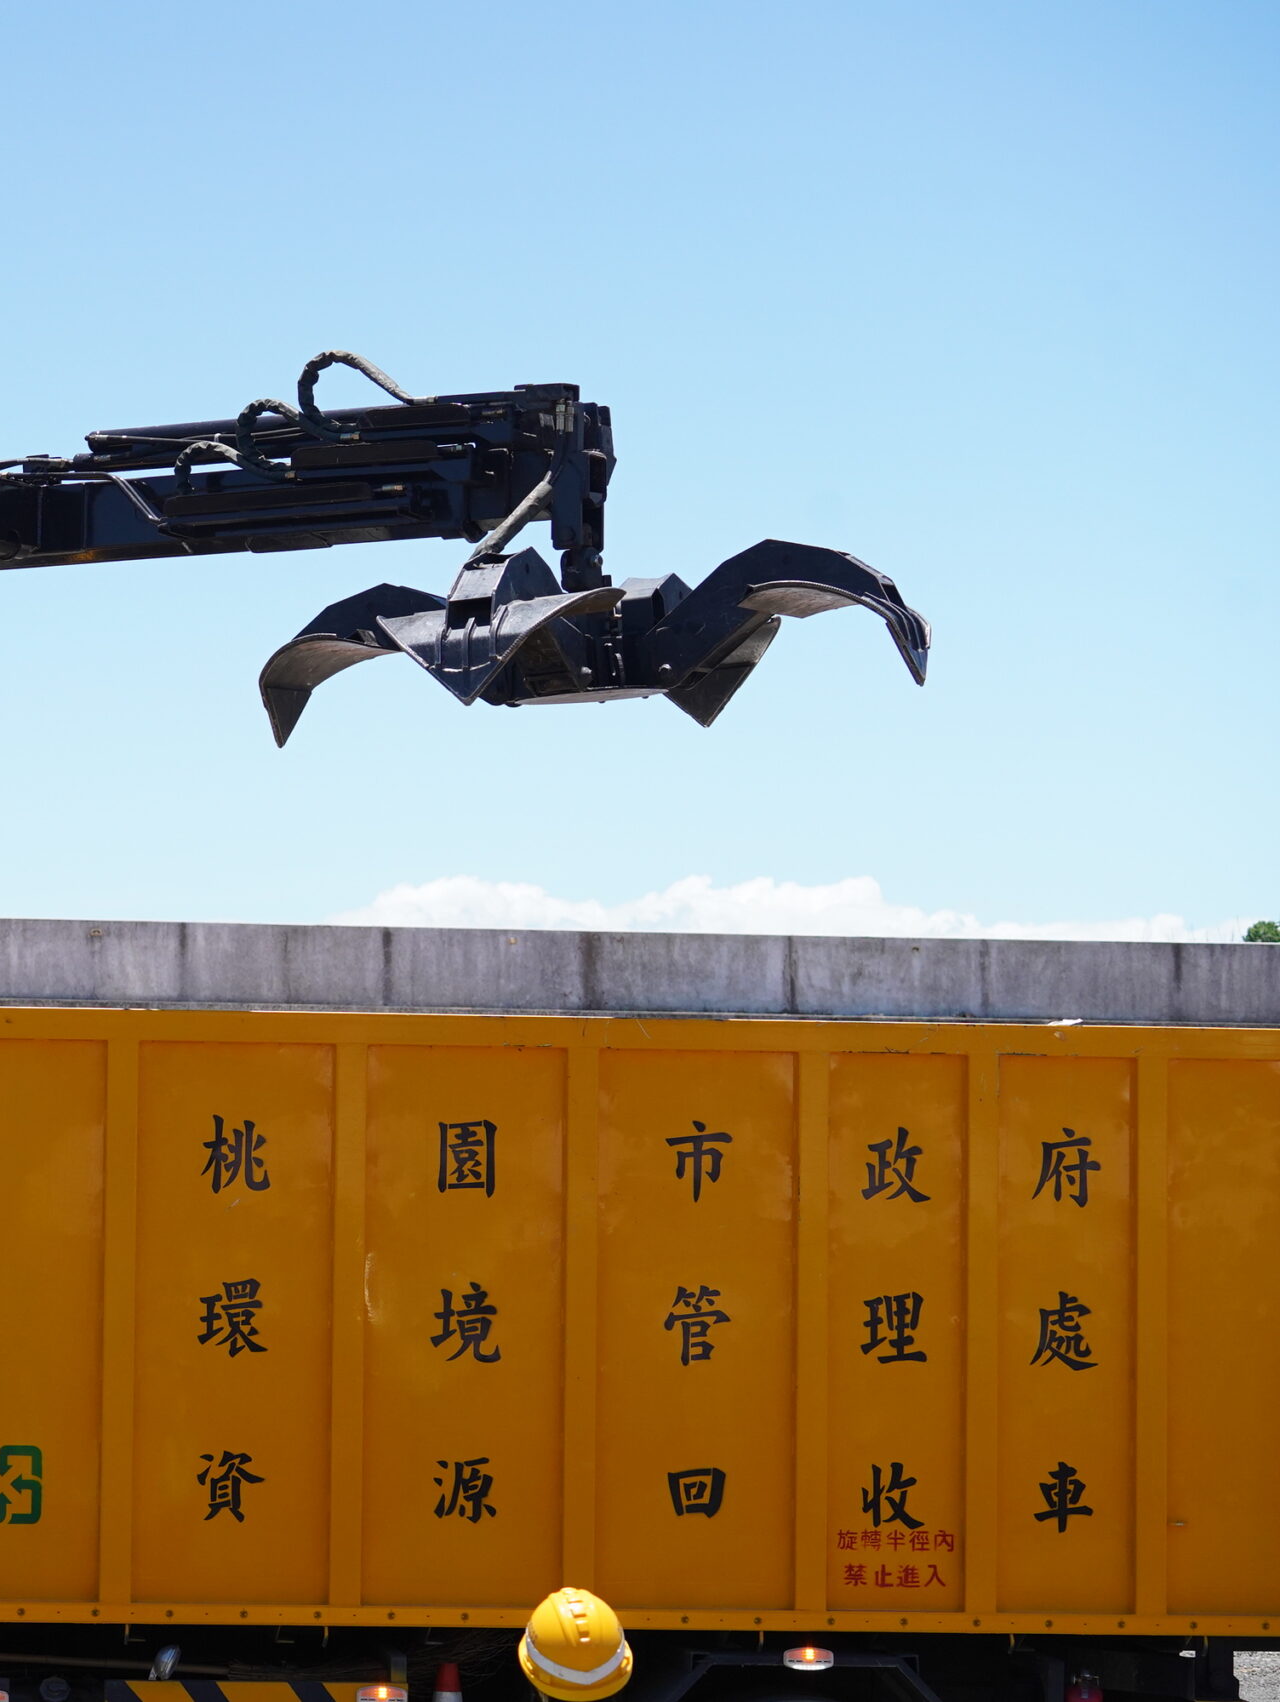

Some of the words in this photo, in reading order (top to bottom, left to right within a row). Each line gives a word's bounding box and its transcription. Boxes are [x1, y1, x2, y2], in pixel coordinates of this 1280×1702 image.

[202, 1115, 1100, 1207] 桃園市政府
[197, 1279, 1098, 1371] 環境管理處
[197, 1450, 1093, 1533] 資源回收車
[837, 1529, 955, 1553] 旋轉半徑內
[843, 1563, 947, 1588] 禁止進入
